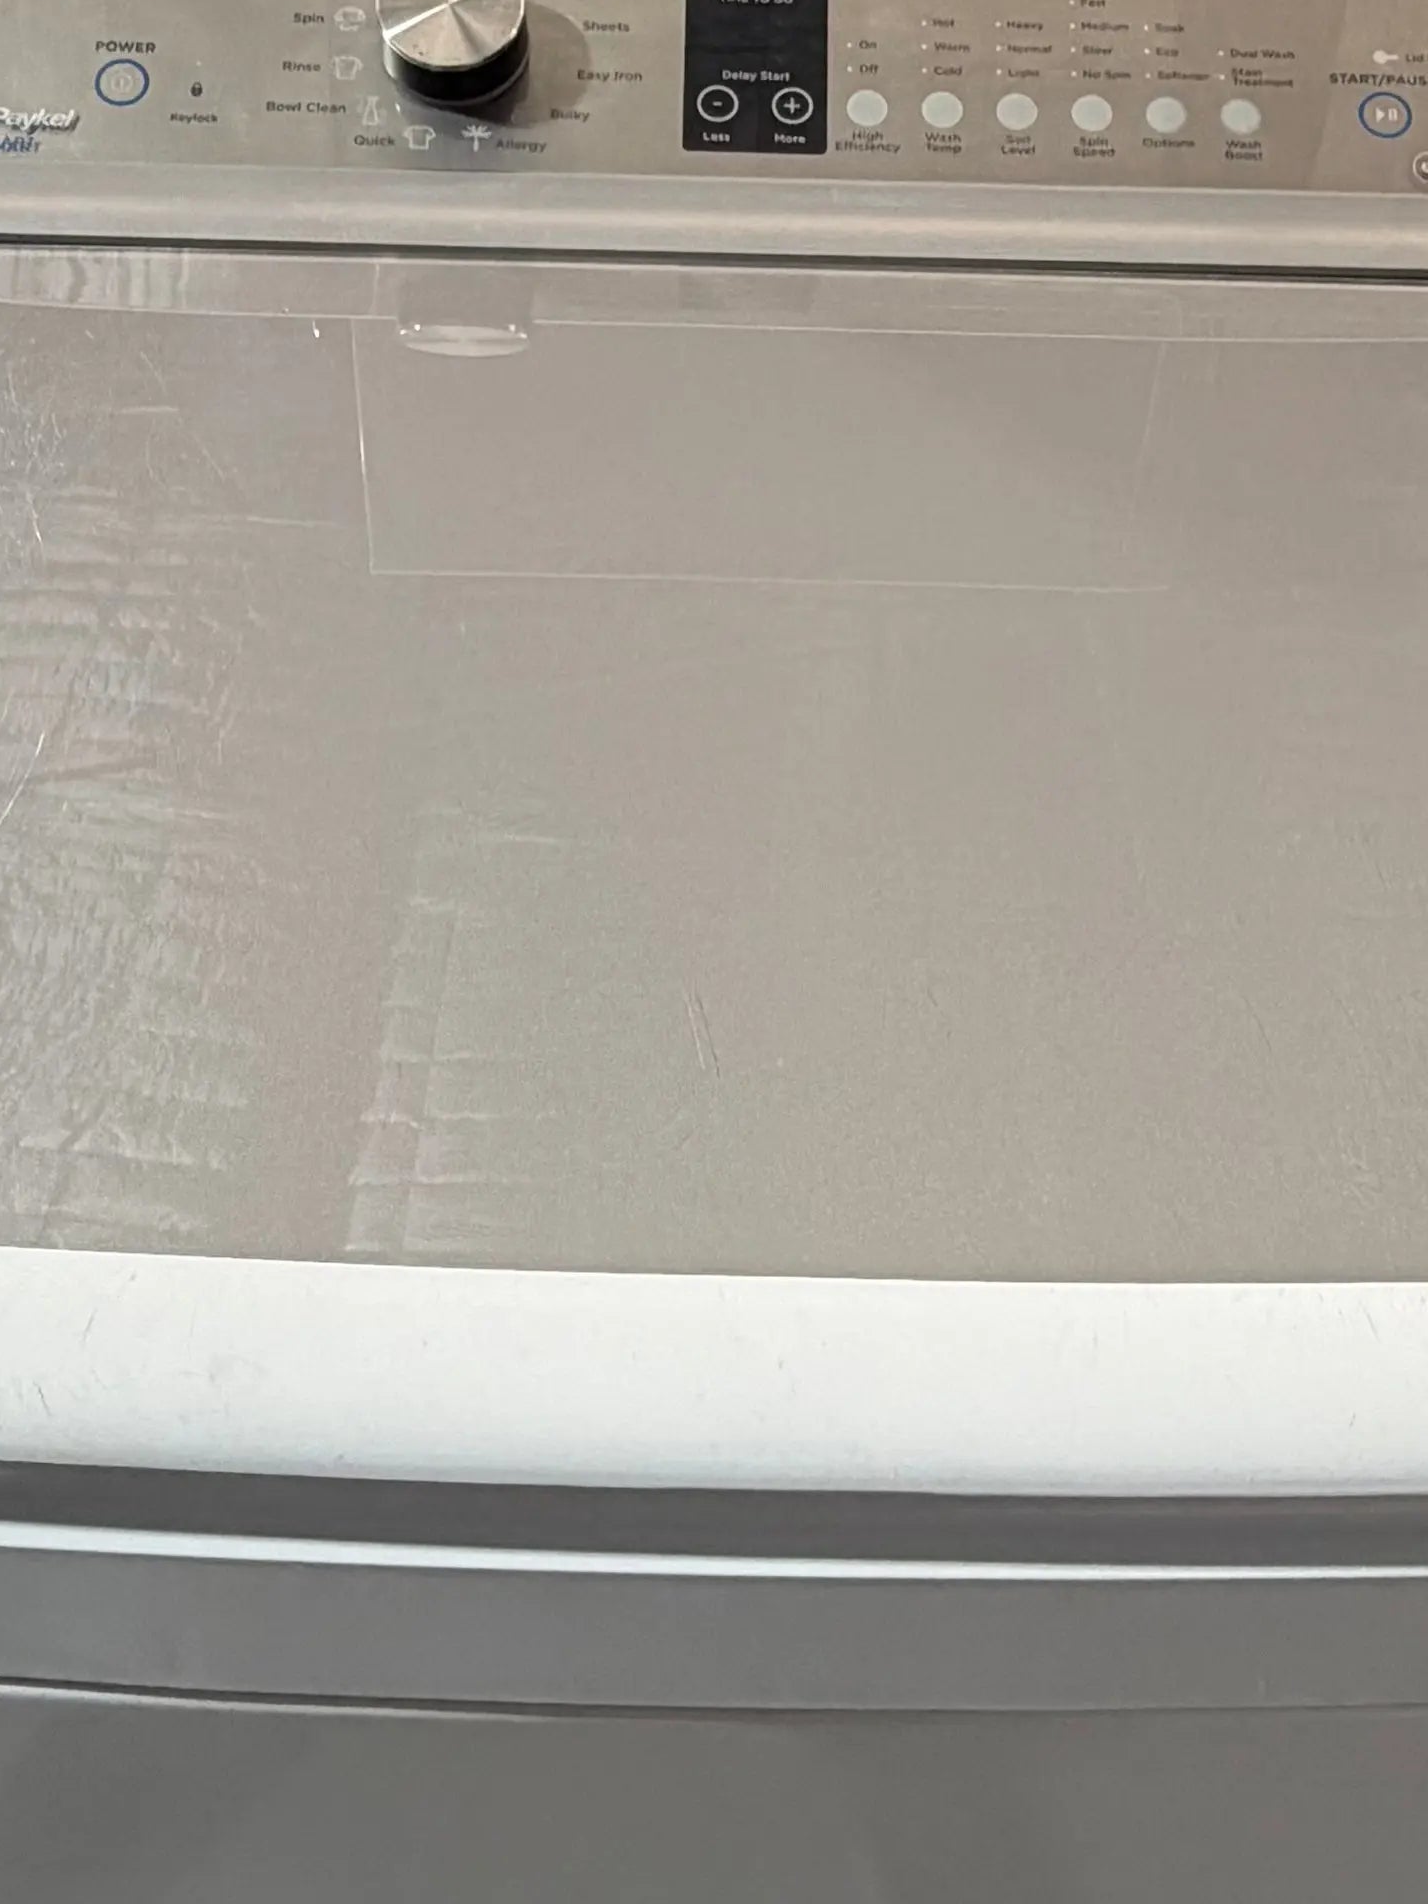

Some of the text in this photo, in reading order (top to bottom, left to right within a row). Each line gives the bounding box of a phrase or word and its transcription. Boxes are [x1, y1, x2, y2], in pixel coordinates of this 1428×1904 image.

[293, 12, 325, 24] Spin
[932, 17, 956, 29] Hot
[582, 20, 630, 33] Sheets
[1006, 20, 1044, 32] Heavy
[1080, 20, 1130, 33] Medium
[1155, 22, 1185, 34] Soak
[95, 40, 157, 54] POWER
[858, 39, 878, 50] On
[934, 41, 970, 53] Warm
[1007, 44, 1053, 55] Normal
[1082, 45, 1114, 56] Slow
[1230, 48, 1296, 60] Dual Wash
[1405, 54, 1425, 65] Lid
[282, 60, 322, 72] Rinse
[859, 63, 879, 75] Off
[933, 65, 963, 77] Cold
[576, 69, 643, 83] Easy Iron
[722, 69, 791, 83] Delay Start
[1008, 68, 1040, 80] Light
[1082, 69, 1102, 80] No
[1231, 67, 1264, 78] Stain
[1232, 77, 1294, 89] Treatment
[265, 100, 347, 114] Bowl Clean
[170, 112, 219, 124] Keylock
[549, 108, 590, 123] Bulky
[353, 134, 396, 147] Quick
[702, 131, 731, 143] Less
[774, 132, 807, 145] More
[852, 130, 884, 142] High
[925, 132, 962, 144] Wash
[495, 138, 547, 153] Allergy
[834, 140, 901, 155] Efficiency
[1079, 136, 1109, 149] Spin
[1142, 137, 1196, 150] Options
[1225, 139, 1263, 151] Wash
[925, 142, 963, 156] Temp
[1000, 144, 1036, 156] Level
[1073, 146, 1116, 159] Speed
[1224, 150, 1264, 162] Boost
